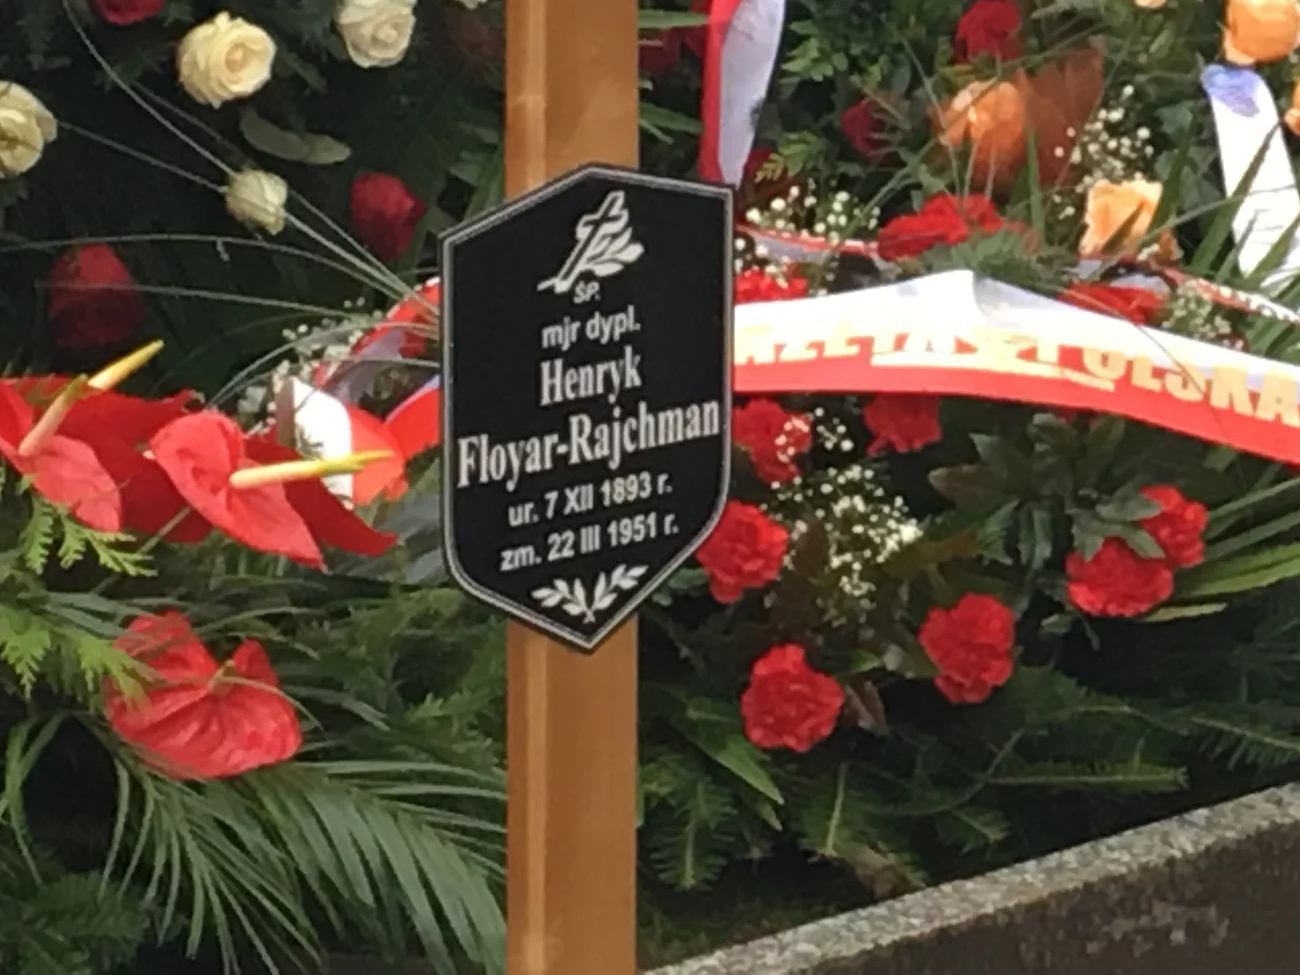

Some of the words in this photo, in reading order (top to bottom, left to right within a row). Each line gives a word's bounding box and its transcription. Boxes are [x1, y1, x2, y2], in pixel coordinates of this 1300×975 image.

[541, 315, 581, 352] mjr
[585, 304, 642, 345] dypl.
[540, 344, 643, 406] Henryk
[457, 399, 720, 492] Floyar-Rajchman
[508, 501, 540, 527] ur.
[544, 490, 559, 519] 7
[563, 483, 594, 515] XII
[601, 470, 651, 507] 1893
[656, 472, 673, 495] r.
[500, 544, 542, 572] zm.
[547, 529, 575, 562] 22
[580, 524, 600, 555] III
[607, 511, 657, 547] 1951
[663, 513, 679, 536] r.
